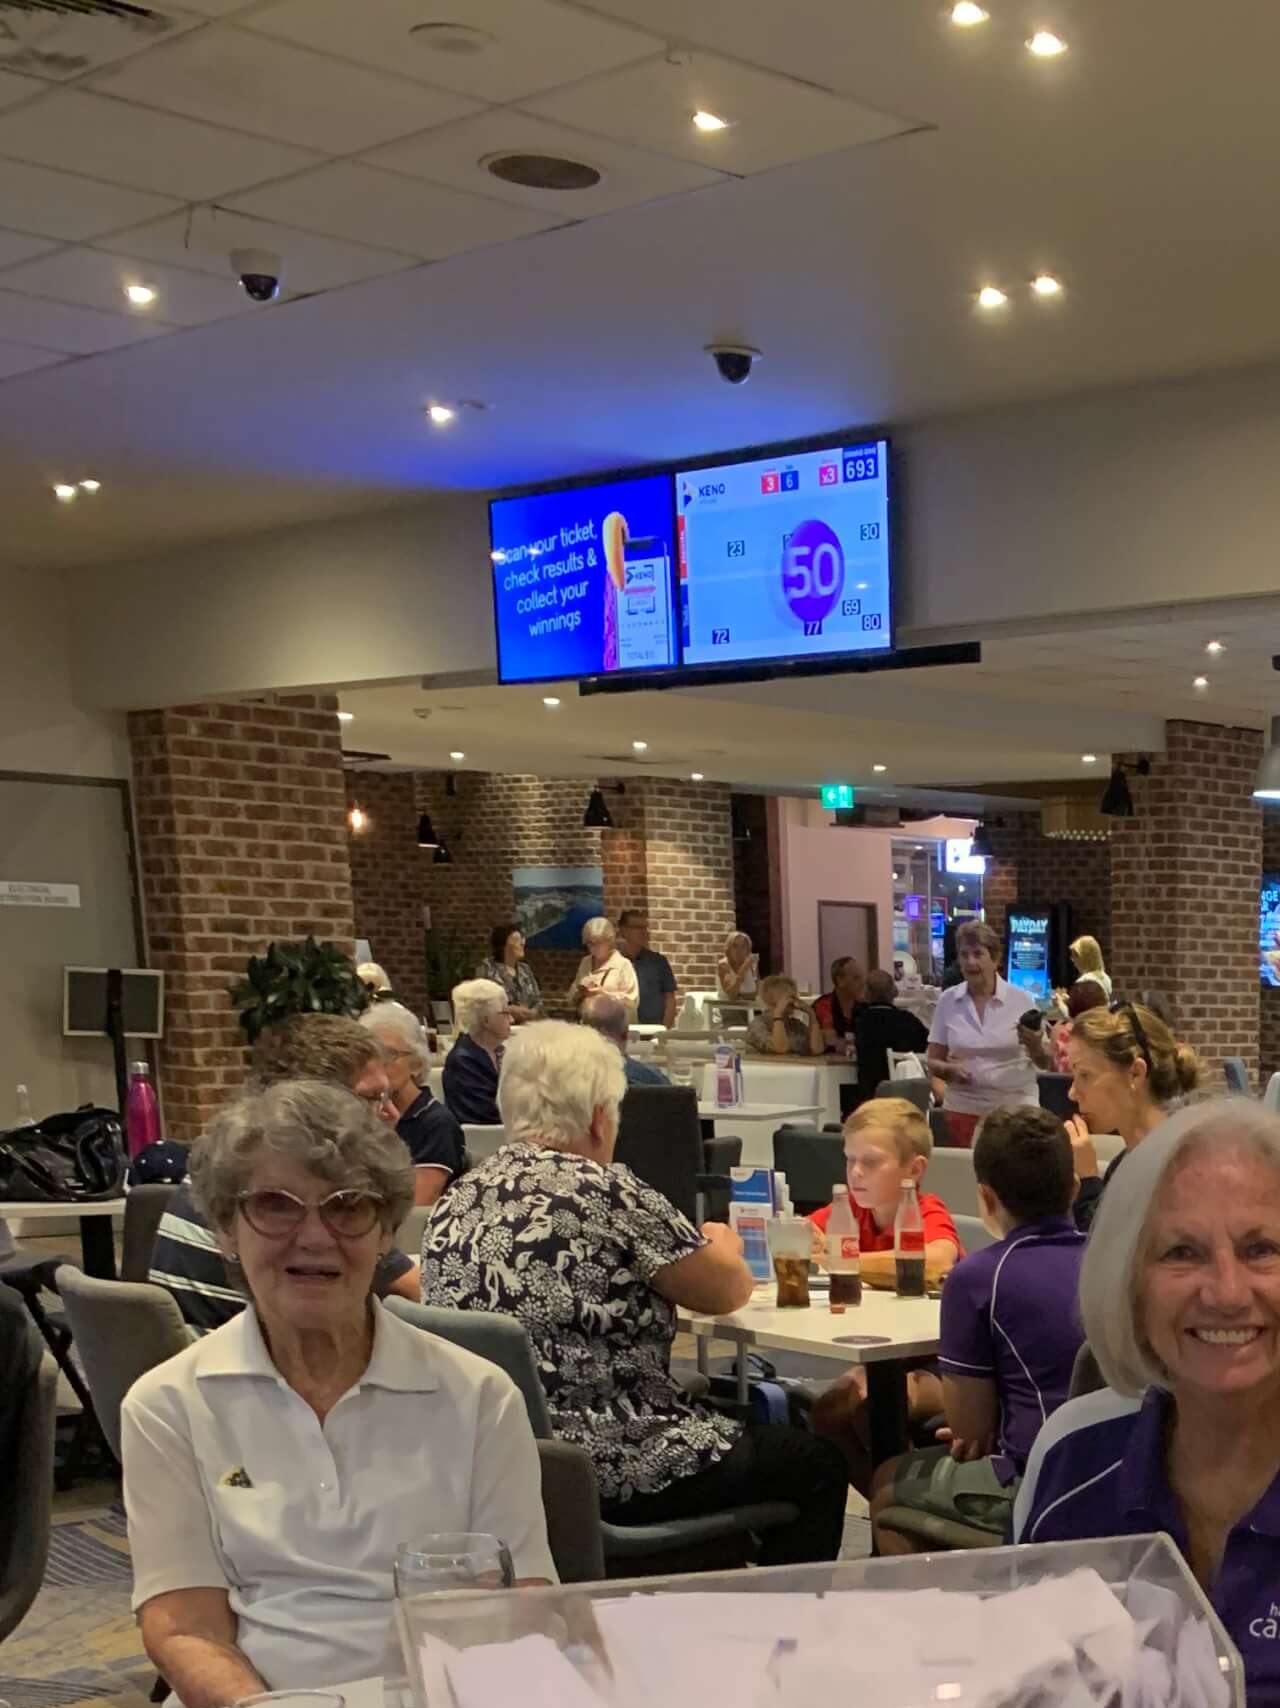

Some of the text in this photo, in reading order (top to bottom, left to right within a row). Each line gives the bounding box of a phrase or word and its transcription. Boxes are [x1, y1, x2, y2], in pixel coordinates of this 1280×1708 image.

[845, 458, 876, 480] 693
[698, 483, 726, 498] KENO
[861, 524, 879, 540] 30
[498, 544, 528, 566] Scan
[529, 535, 558, 562] your
[728, 541, 743, 557] 23
[503, 547, 598, 592] check results &
[787, 543, 841, 599] 50
[516, 581, 590, 614] collect your
[843, 600, 860, 615] 69
[528, 610, 582, 637] winnings
[863, 615, 880, 630] 80
[714, 630, 728, 644] 72
